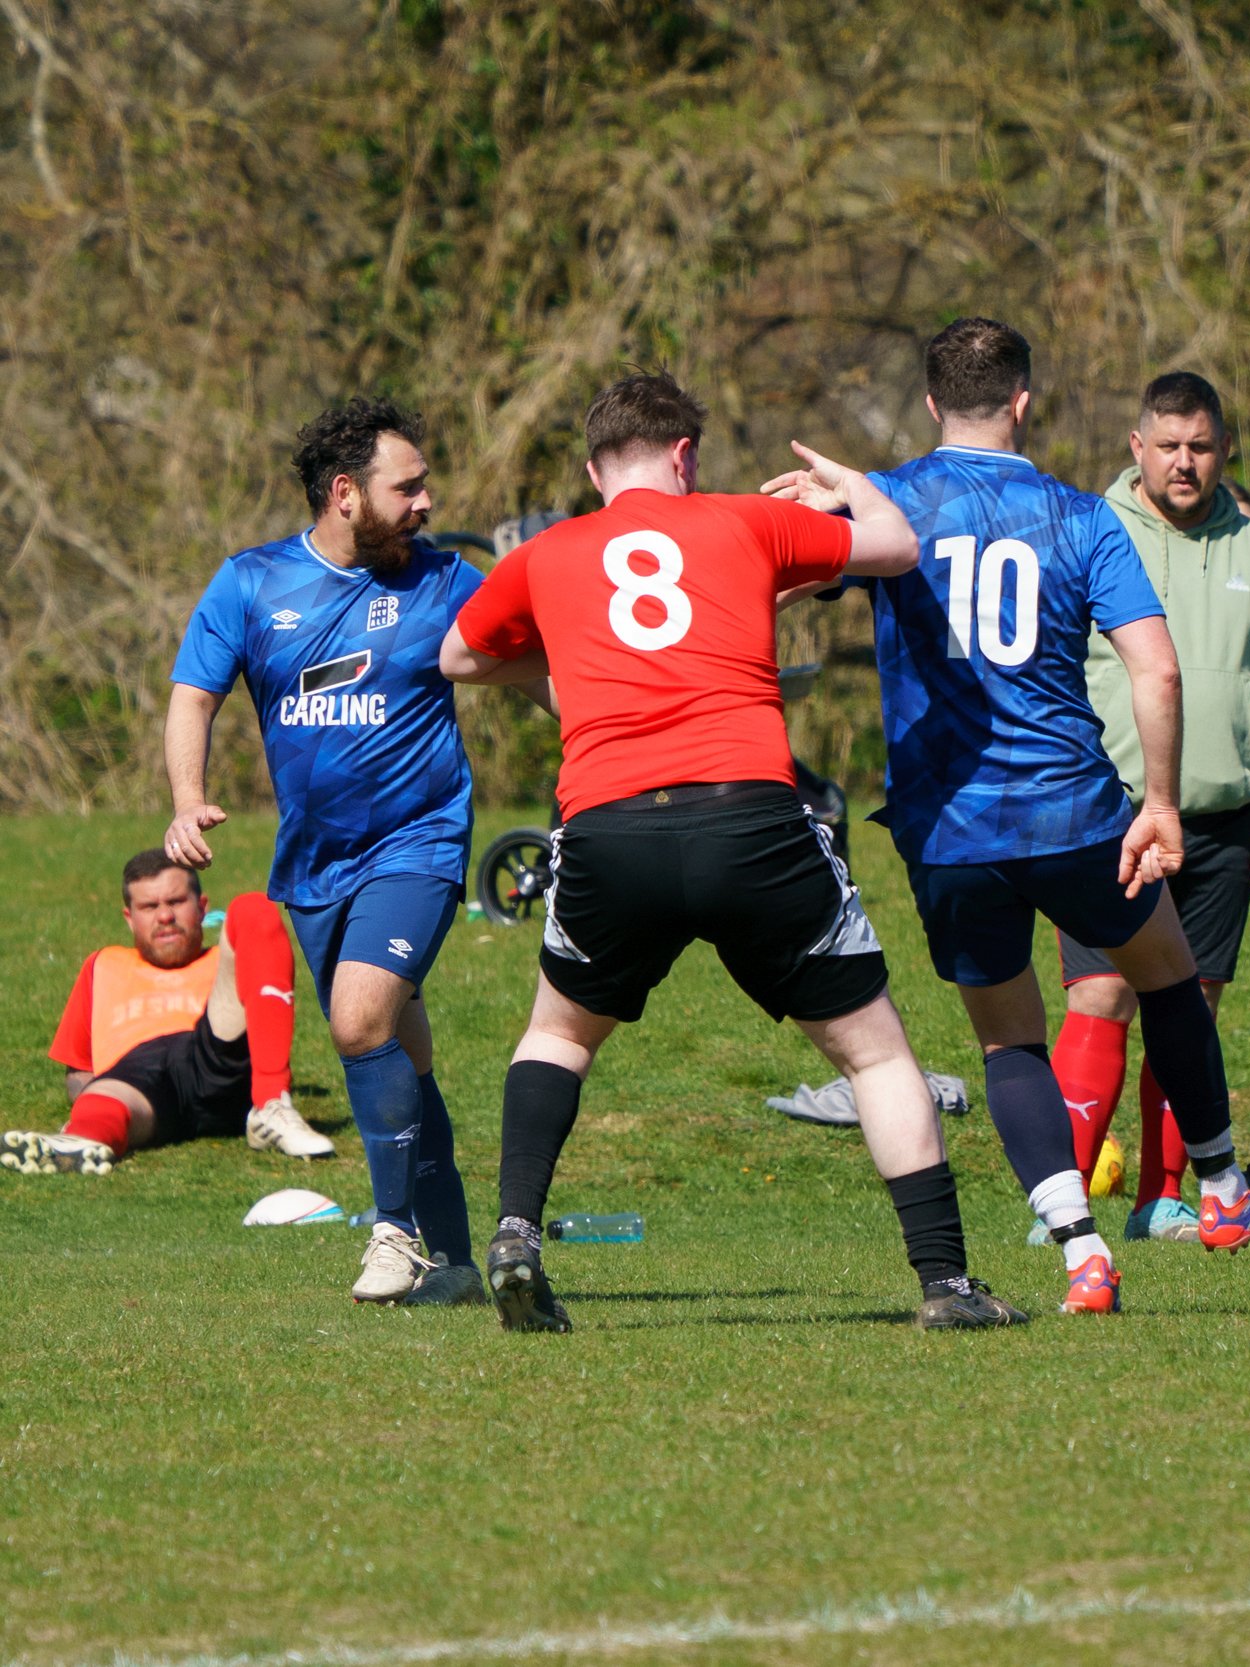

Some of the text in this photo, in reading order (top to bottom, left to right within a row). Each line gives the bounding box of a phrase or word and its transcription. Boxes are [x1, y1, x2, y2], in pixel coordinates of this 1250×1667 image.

[603, 530, 692, 651] 8
[935, 535, 1039, 666] 10
[280, 694, 386, 726] CARLING
